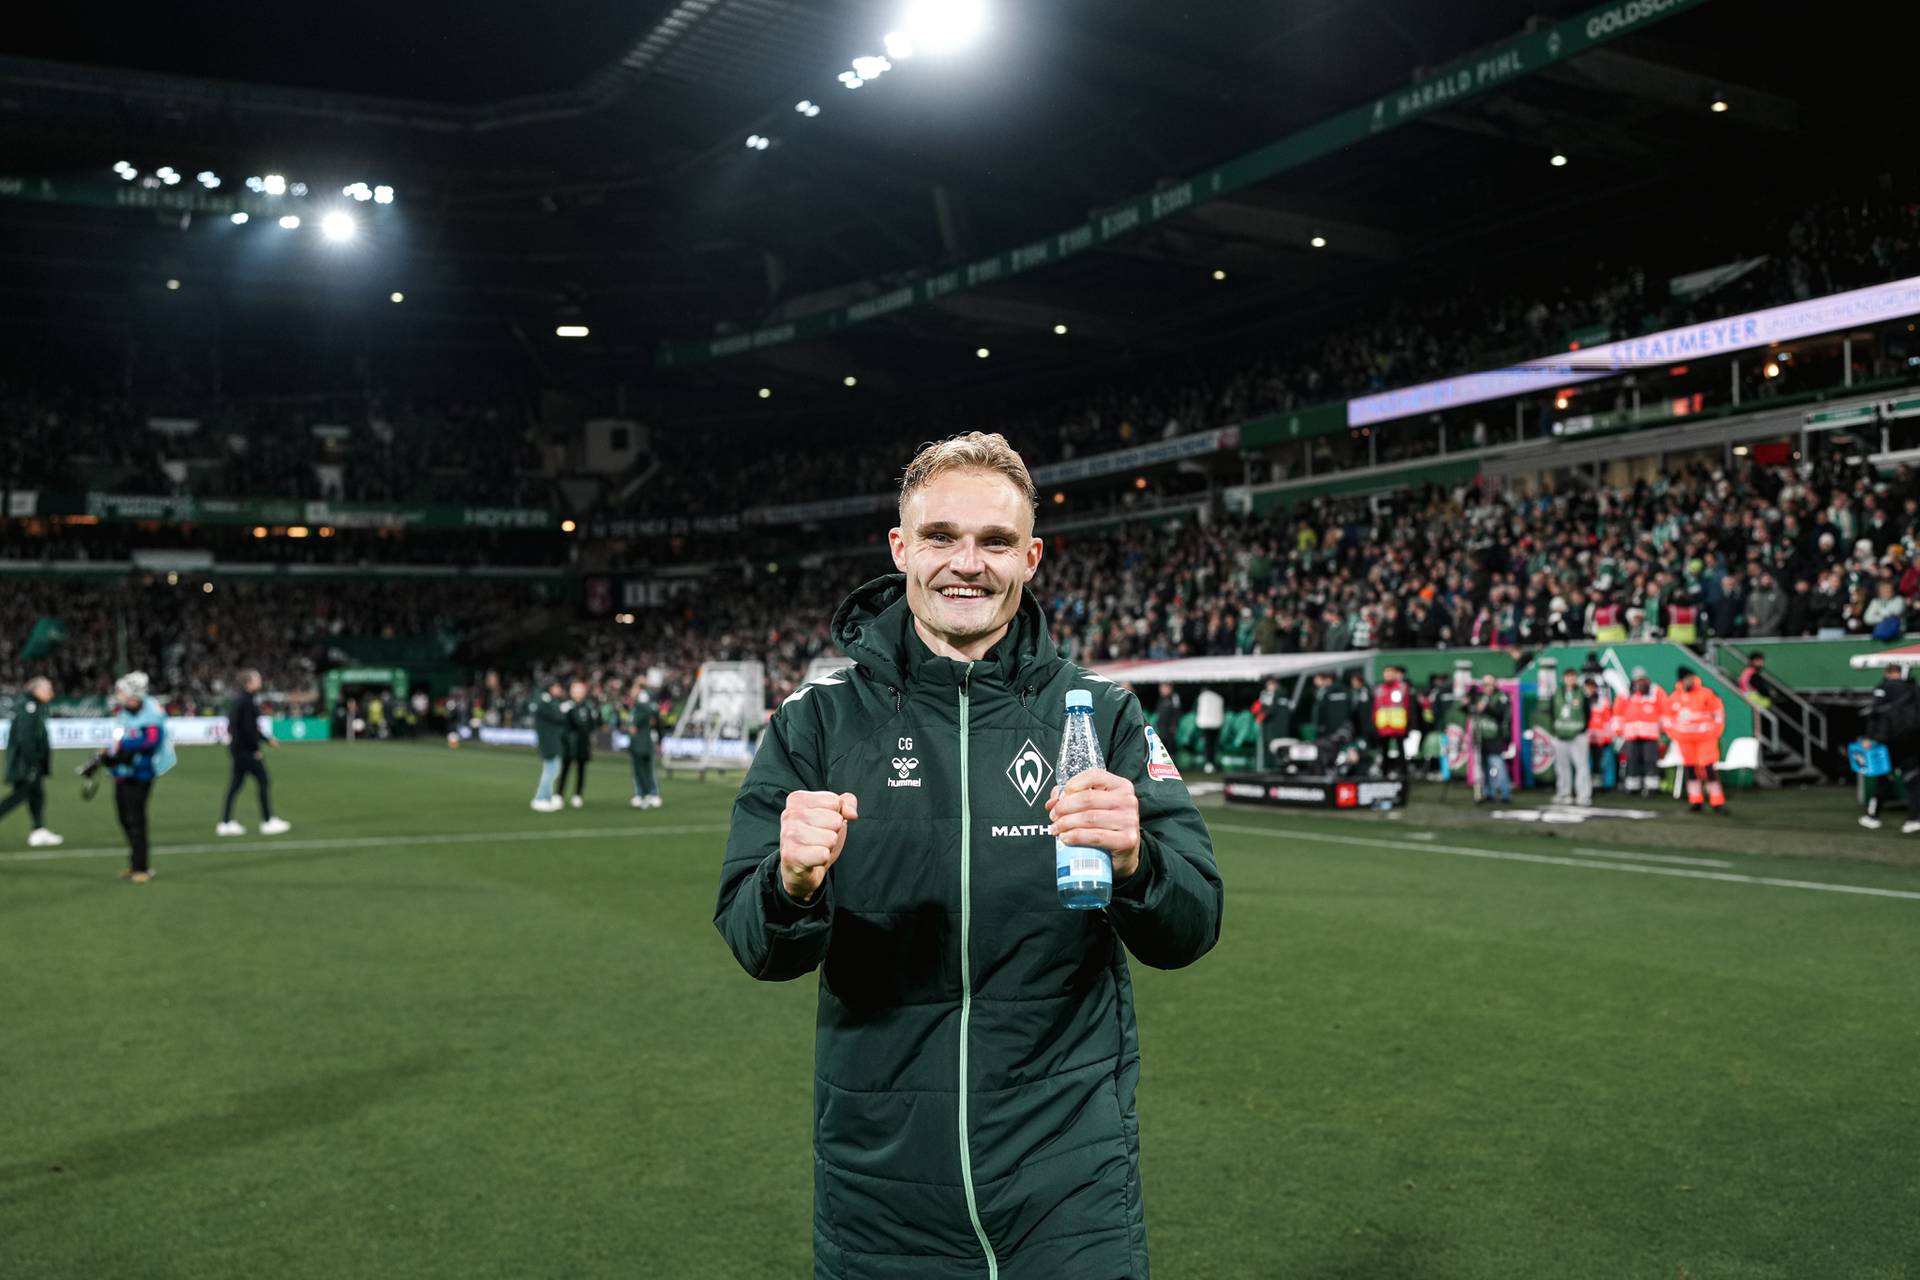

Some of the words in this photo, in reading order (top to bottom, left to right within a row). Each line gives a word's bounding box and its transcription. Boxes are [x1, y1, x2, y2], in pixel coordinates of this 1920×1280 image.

[1586, 0, 1684, 39] GOLDSC
[1397, 69, 1472, 116] HARALD
[1477, 49, 1524, 86] PIHL
[1609, 315, 1757, 373] STRATMEYER
[463, 508, 550, 528] HOYER
[898, 736, 913, 751] CG
[887, 776, 922, 788] hummel
